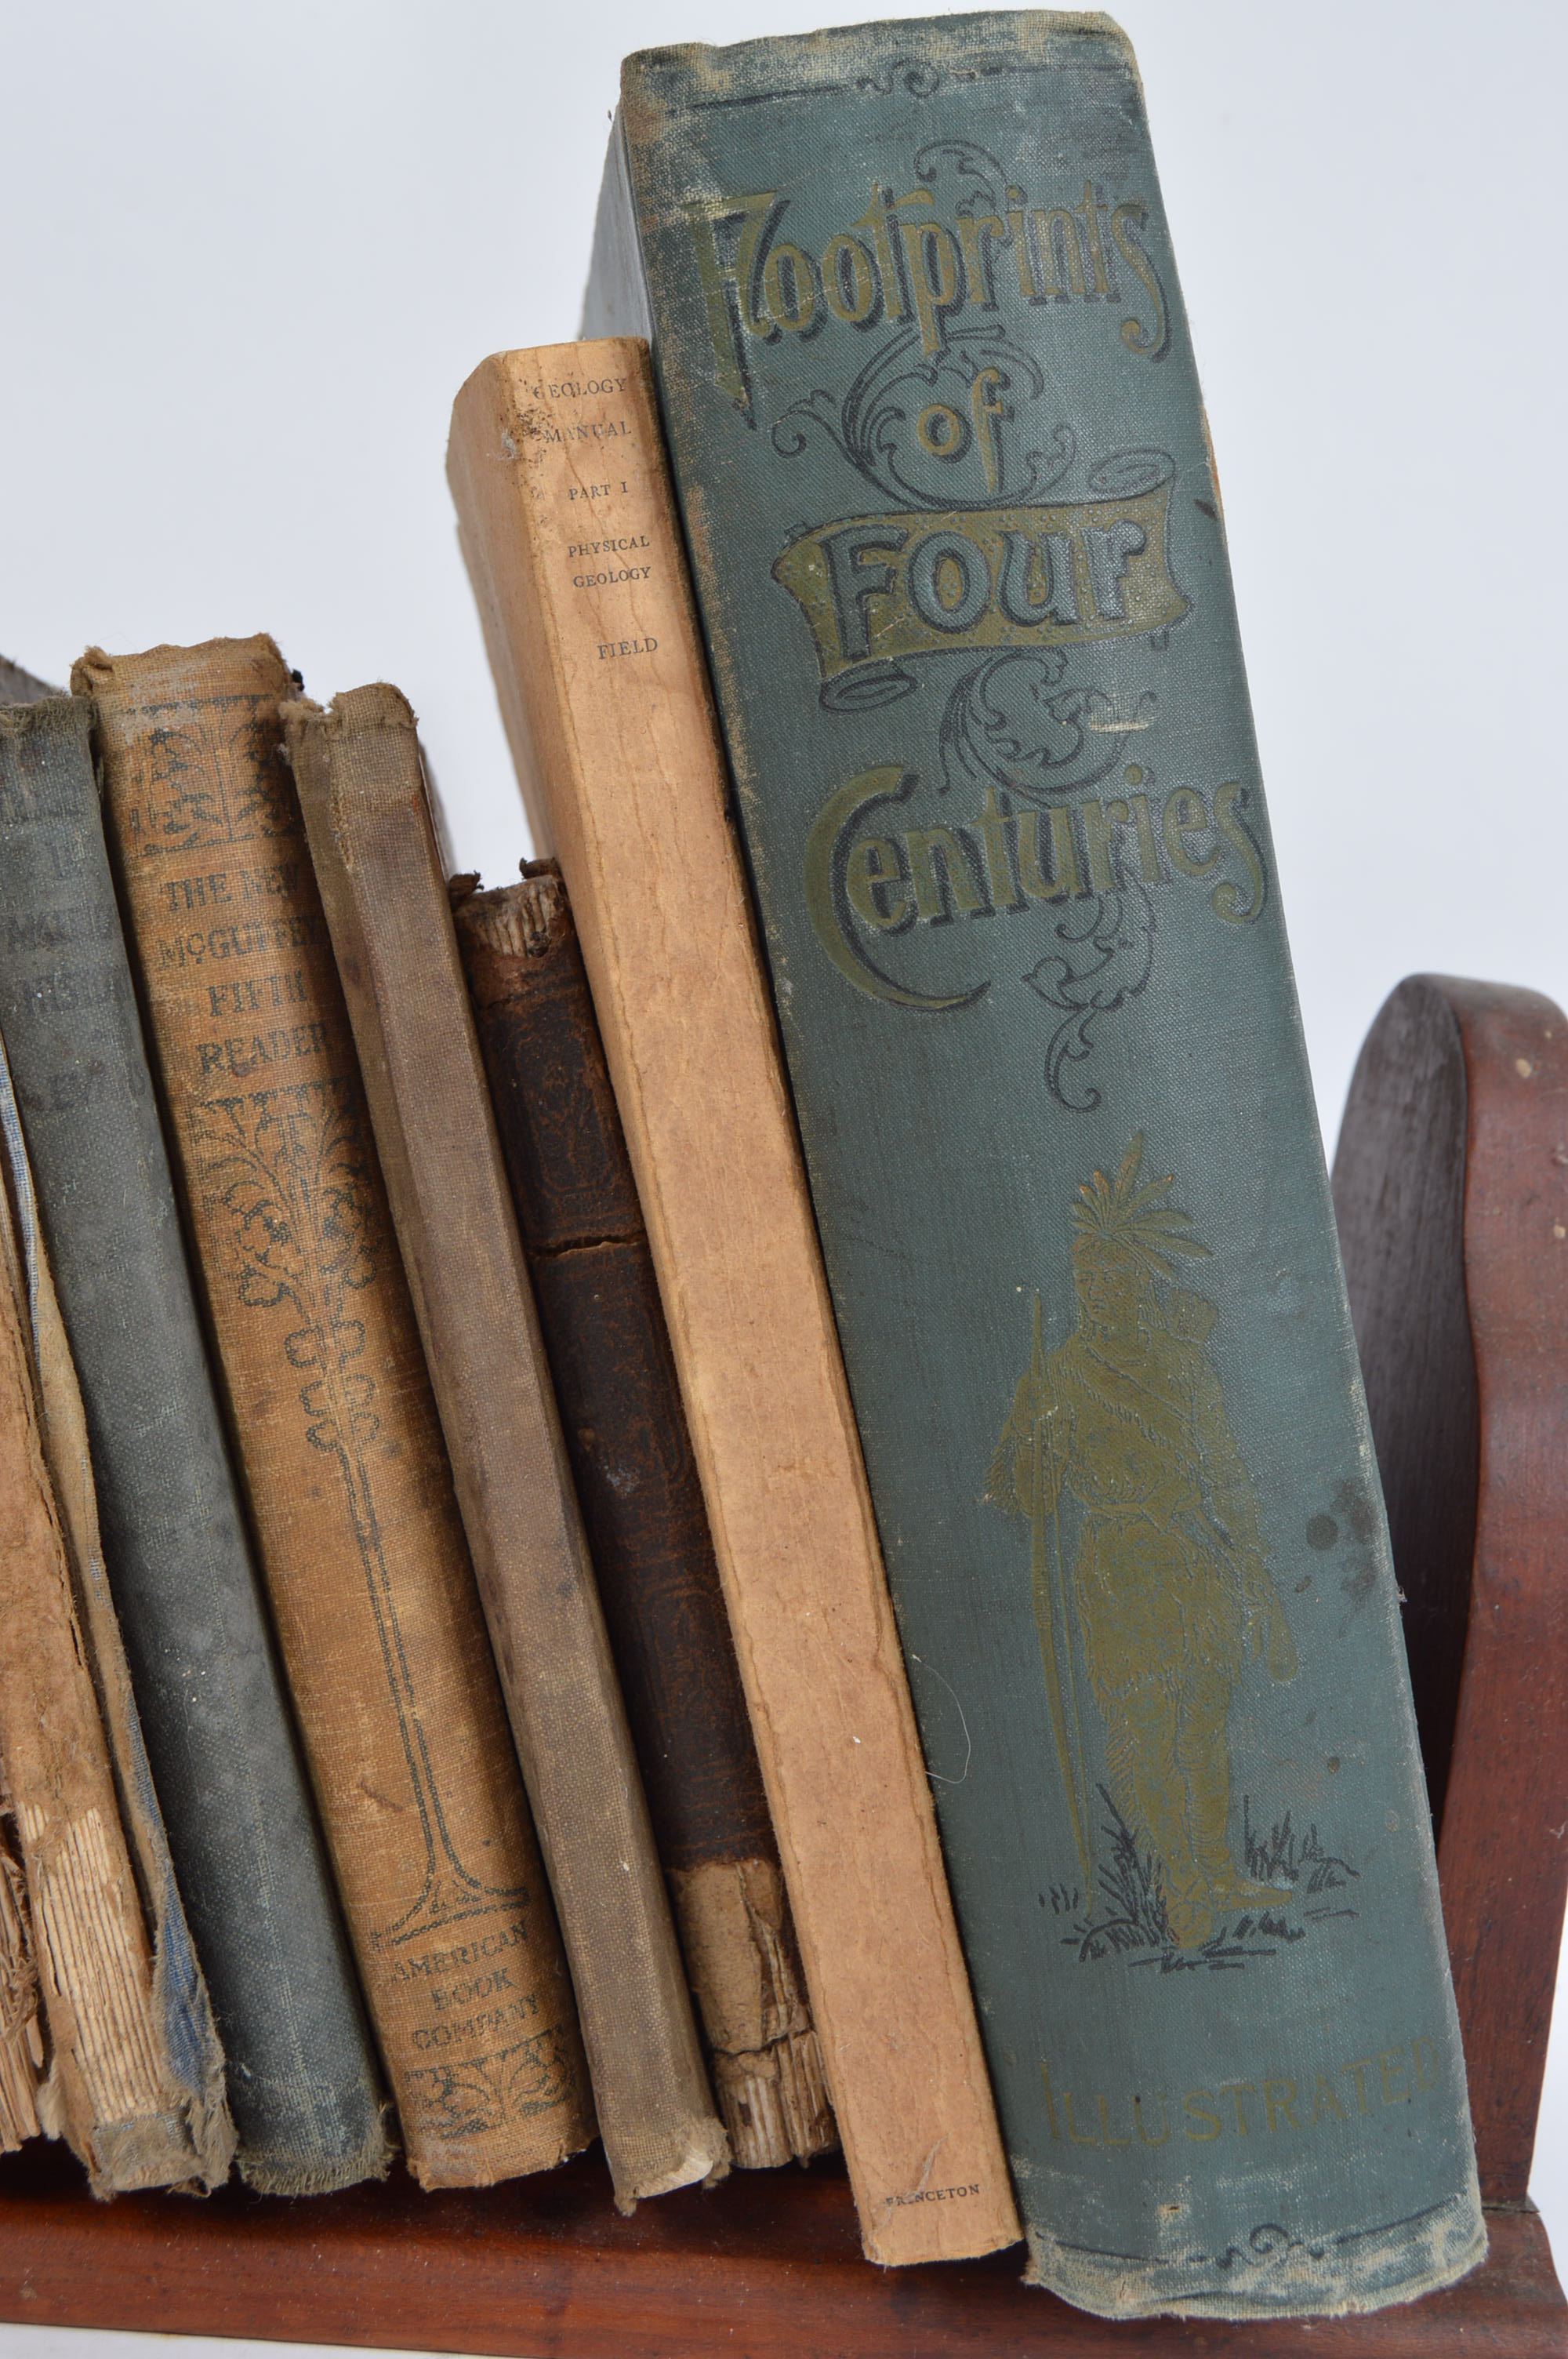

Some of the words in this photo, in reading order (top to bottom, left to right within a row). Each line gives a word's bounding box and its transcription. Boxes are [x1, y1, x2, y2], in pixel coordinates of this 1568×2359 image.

[687, 180, 1171, 429] Footprints
[533, 377, 627, 400] GEOLOGY
[545, 420, 632, 444] MANUAL
[916, 365, 1017, 500] of
[569, 483, 611, 502] PART
[620, 481, 628, 495] I
[568, 535, 651, 558] PHYSICAL
[573, 566, 652, 588] GEOLOGY
[597, 637, 659, 660] FIELD
[165, 872, 232, 911] THE
[238, 863, 299, 900] NEW
[804, 764, 1268, 1012] Centuries
[207, 970, 308, 1017] FIFTH
[197, 1022, 332, 1074] READER
[392, 1919, 528, 1983] AMERICAN
[431, 1967, 516, 2011] BOOK
[412, 1993, 541, 2051] COMPANY
[1039, 2037, 1440, 2146] ILLUSTRATED
